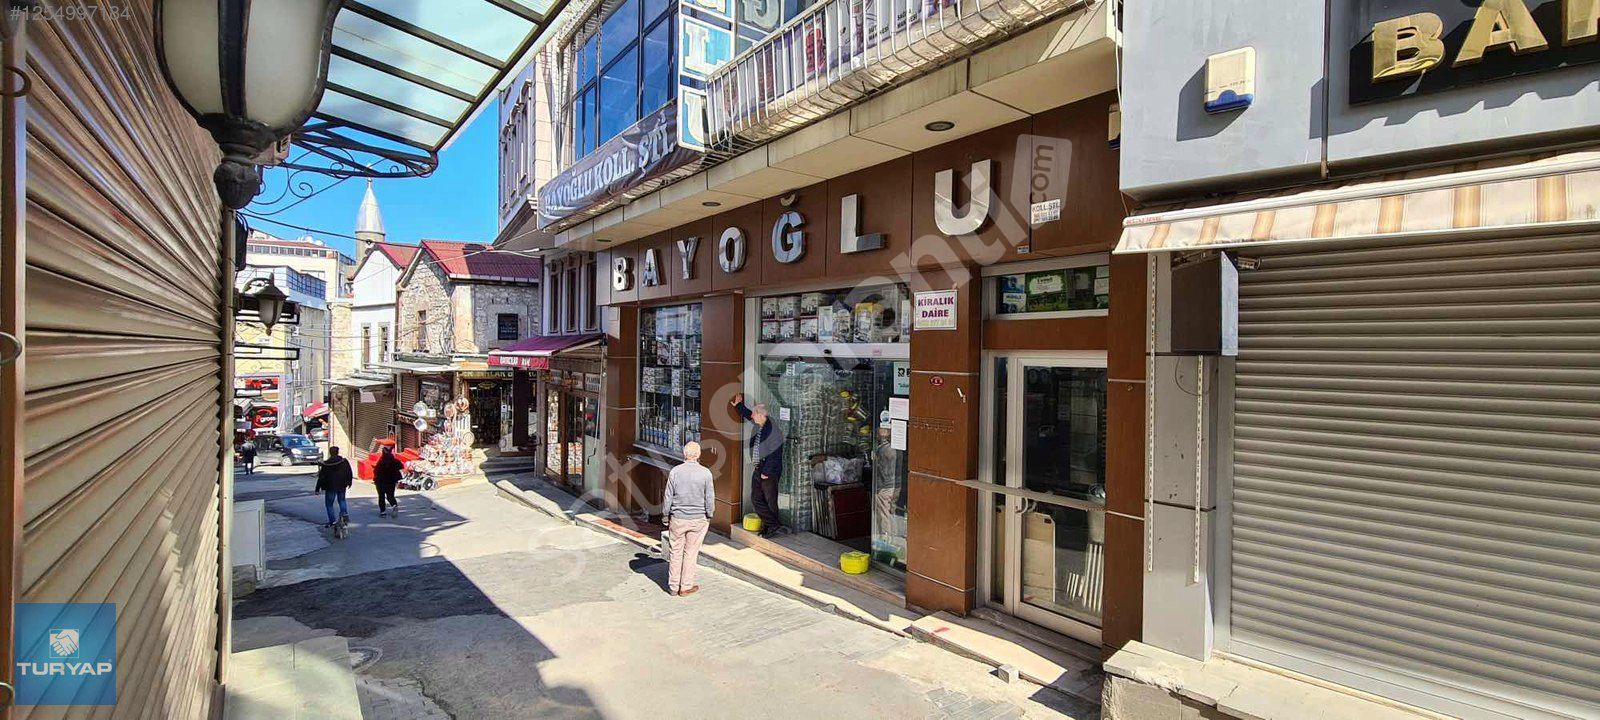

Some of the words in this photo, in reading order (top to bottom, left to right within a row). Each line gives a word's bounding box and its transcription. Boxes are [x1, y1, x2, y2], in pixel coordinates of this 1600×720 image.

[613, 159, 992, 291] BAYOĞLU
[917, 296, 955, 307] KİRALIK
[921, 308, 950, 318] DAİRE
